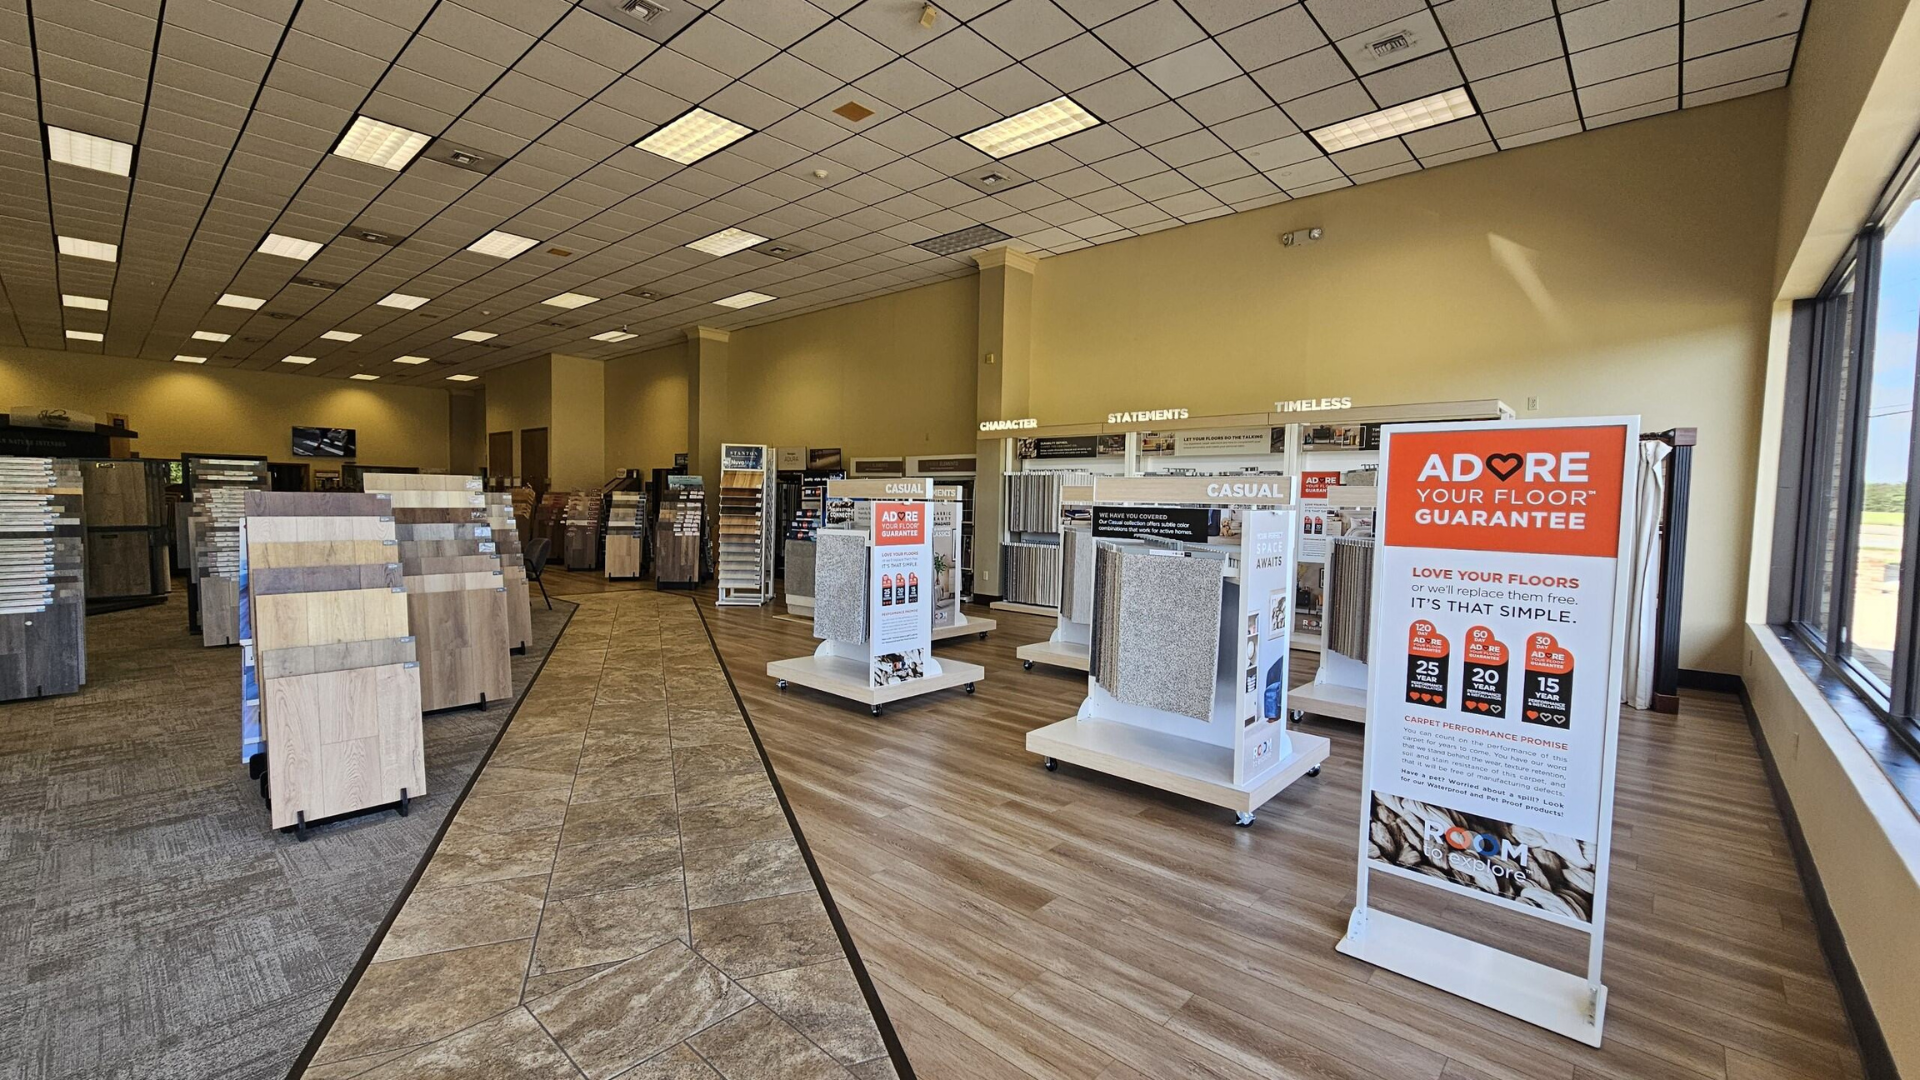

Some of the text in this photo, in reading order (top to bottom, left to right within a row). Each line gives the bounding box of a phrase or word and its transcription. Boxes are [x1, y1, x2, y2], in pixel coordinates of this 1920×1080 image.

[1274, 397, 1352, 413] TIMELESS
[1108, 408, 1188, 424] STATEMENTS
[980, 419, 1037, 431] CHARACTER
[886, 484, 923, 493] CASUAL
[1206, 483, 1284, 498] CASUAL
[1417, 489, 1483, 504] YOUR
[1415, 509, 1586, 529] GUARANTEE
[1256, 542, 1282, 554] SPACE
[1256, 556, 1282, 569] AWAITS
[1413, 567, 1579, 589] LOVE YOUR FLOORS
[1458, 587, 1504, 599] replace
[1508, 590, 1543, 602] them
[1548, 593, 1578, 606] free.
[1447, 600, 1493, 615] THAT
[1500, 605, 1577, 624] SIMPLE.
[1474, 630, 1488, 638] 60
[1536, 636, 1550, 645] 30
[1416, 660, 1439, 676] 25
[1472, 668, 1499, 684] 20
[1473, 683, 1496, 691] YEAR
[1538, 677, 1559, 692] 15
[1535, 692, 1559, 700] YEAR
[1404, 715, 1568, 750] CARPET PERFORMANCE PROMISE
[1487, 744, 1536, 756] performance
[1447, 752, 1469, 760] behind
[1505, 764, 1529, 772] texture
[1452, 761, 1488, 772] resistance
[1477, 774, 1530, 790] manufacturing
[1534, 786, 1565, 797] defects.
[1427, 782, 1467, 795] Waterproof
[1502, 798, 1522, 807] Proof
[1526, 805, 1564, 817] products!
[1449, 779, 1479, 789] Worried
[1483, 787, 1505, 796] about
[1518, 794, 1539, 803] spill?
[1544, 800, 1564, 808] Look
[1424, 820, 1528, 867] ROOM
[1424, 844, 1443, 859] to
